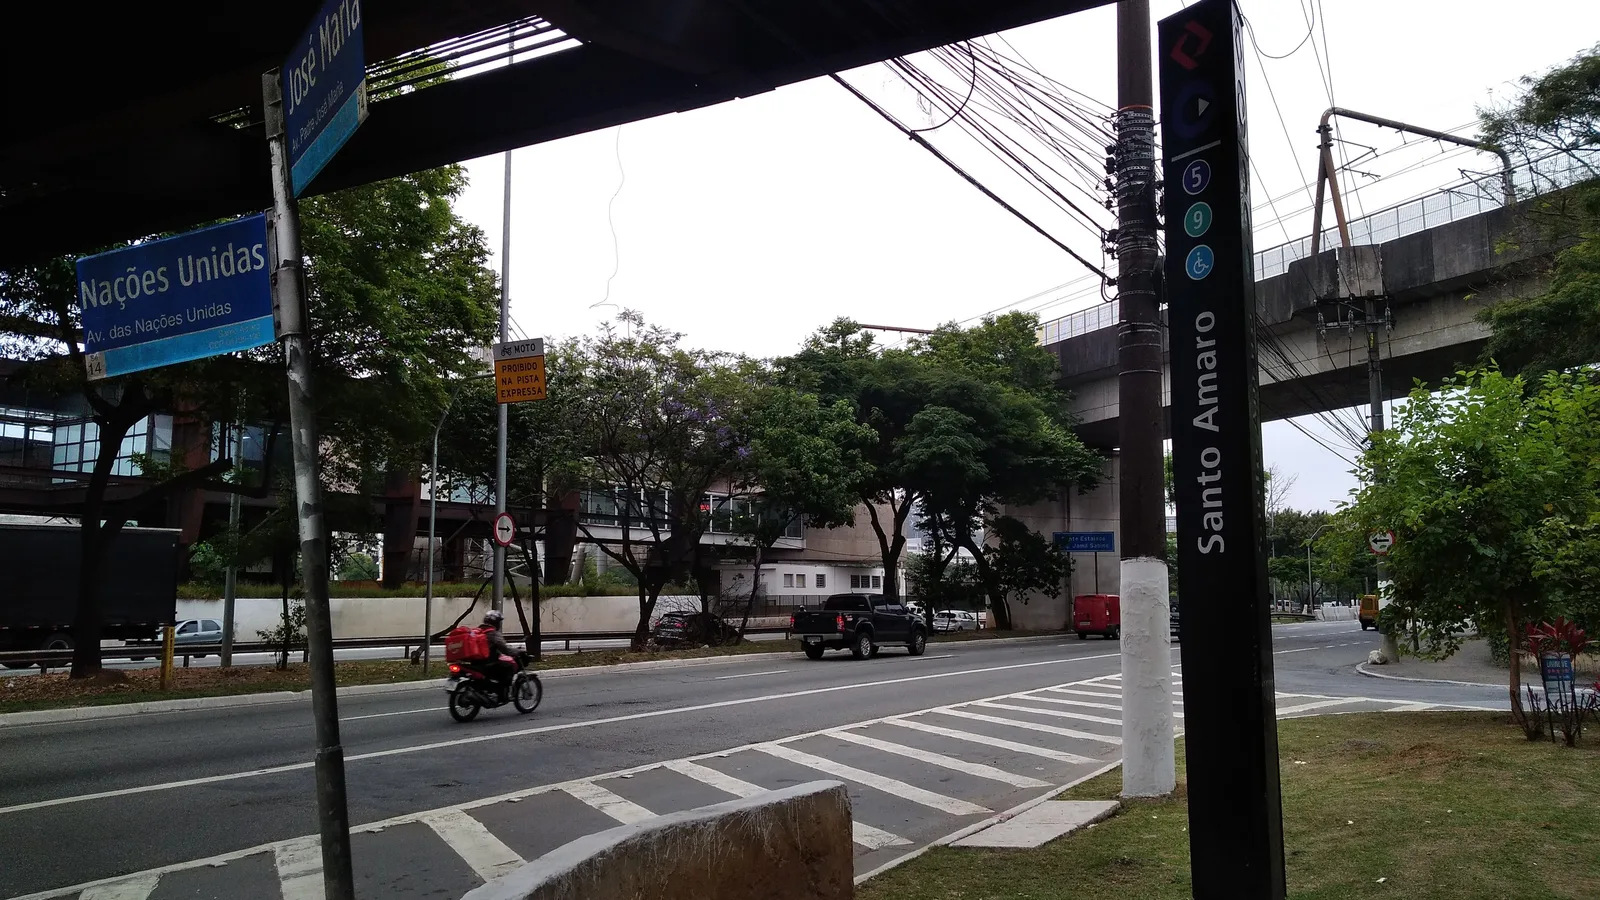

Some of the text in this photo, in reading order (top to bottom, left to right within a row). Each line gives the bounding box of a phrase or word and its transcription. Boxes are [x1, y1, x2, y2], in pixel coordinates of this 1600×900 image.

[289, 34, 316, 115] José
[300, 118, 315, 144] Padre
[315, 98, 328, 125] José
[328, 80, 344, 109] Maria
[1191, 167, 1202, 181] 5
[1193, 213, 1203, 229] 9
[80, 242, 265, 310] Nações Unidas
[86, 301, 232, 344] Av. das Nações Unidas
[514, 343, 536, 353] MOTO
[88, 362, 102, 375] 14
[501, 362, 538, 373] PROIBIDO
[501, 374, 540, 386] NA PISTA
[501, 386, 543, 398] EXPRESSA
[1192, 311, 1225, 554] Santo Amaro
